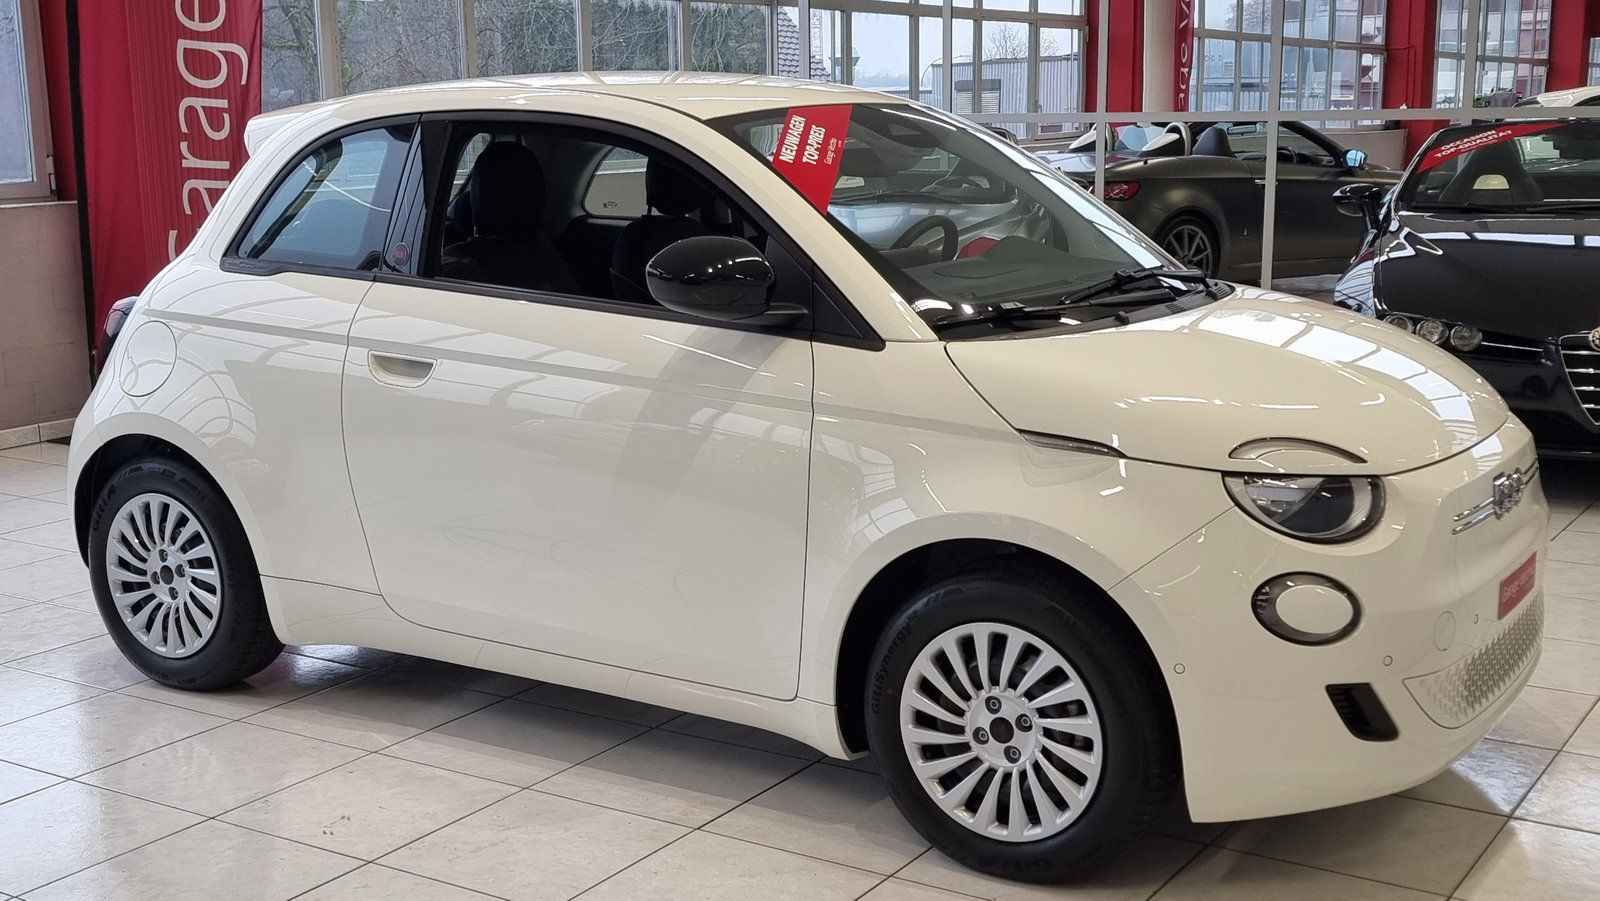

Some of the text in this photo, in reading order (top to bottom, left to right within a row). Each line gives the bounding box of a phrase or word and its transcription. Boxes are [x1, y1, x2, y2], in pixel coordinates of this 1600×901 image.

[779, 115, 807, 164] NEUWAGEN
[802, 124, 826, 165] TOP-PREIS
[1440, 130, 1497, 151] OCCASION
